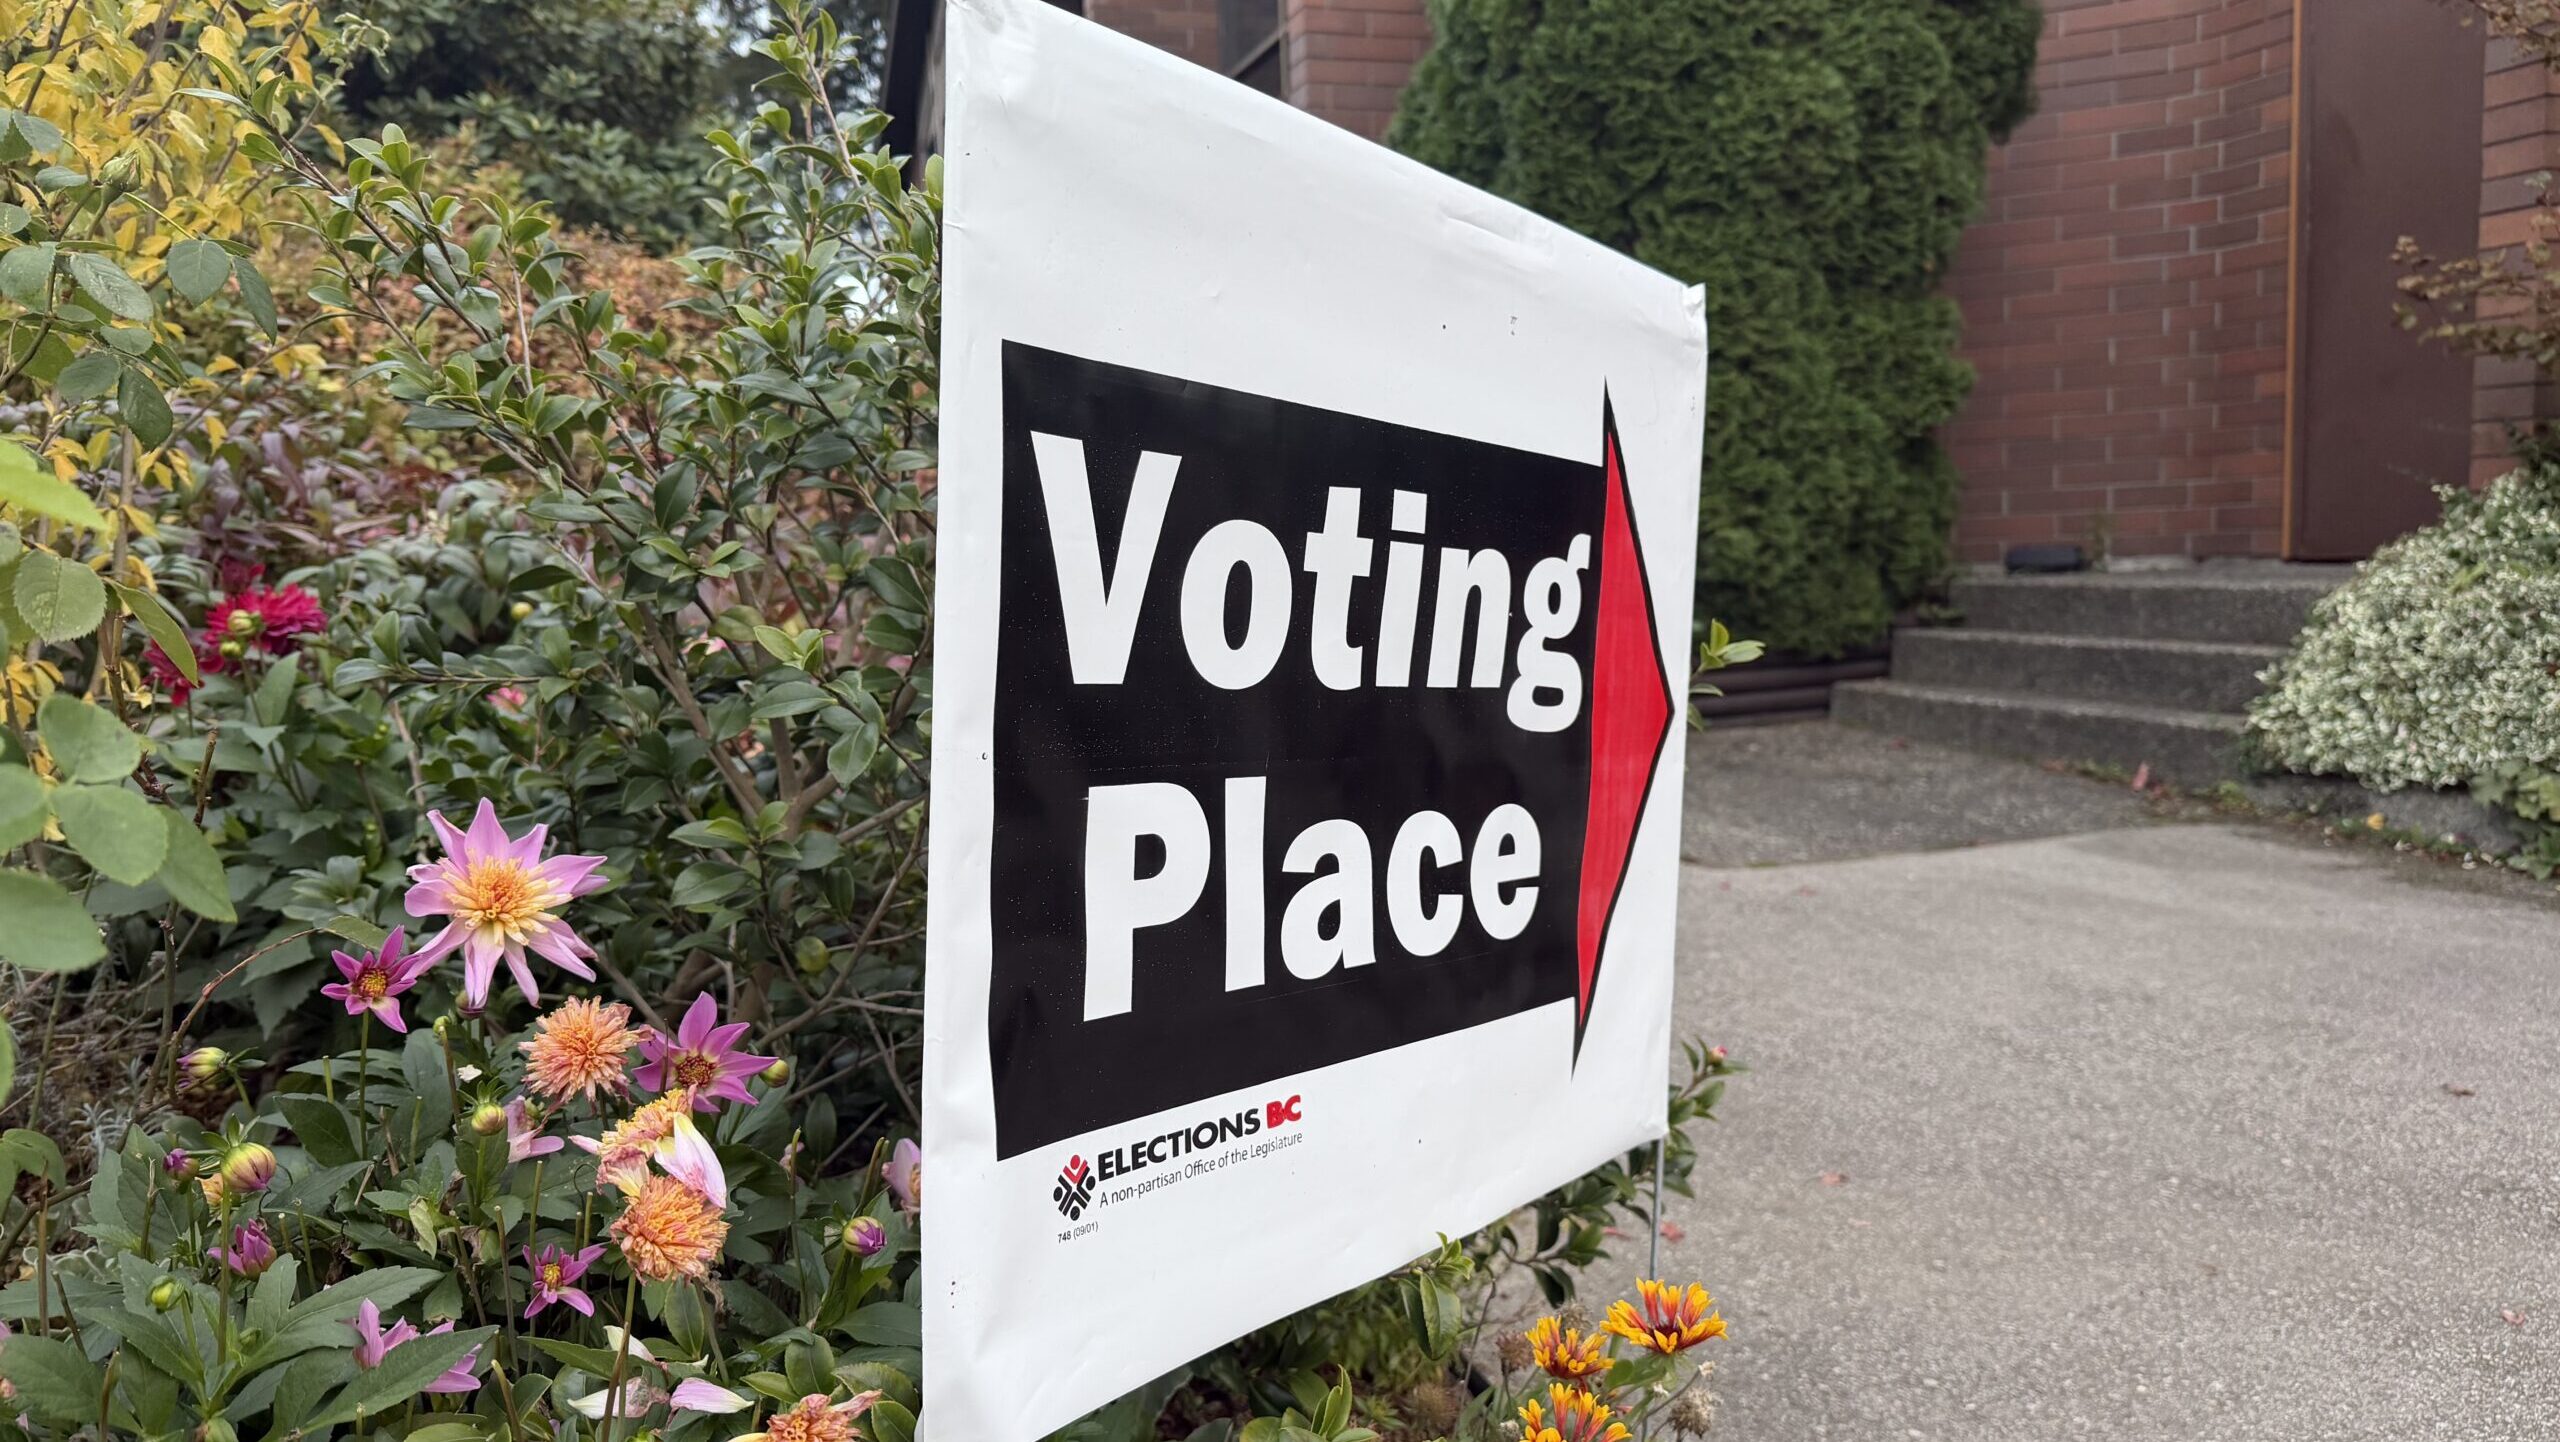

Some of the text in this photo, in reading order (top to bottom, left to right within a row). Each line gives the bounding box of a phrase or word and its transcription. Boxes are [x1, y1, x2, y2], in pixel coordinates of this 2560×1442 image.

[1030, 430, 1591, 733] Voting
[1083, 776, 1542, 1022] Place
[1098, 1094, 1302, 1182] ELECTIONS BC
[1100, 1132, 1303, 1208] A non-partisan Office of the Legislature
[1057, 1230, 1072, 1244] 748
